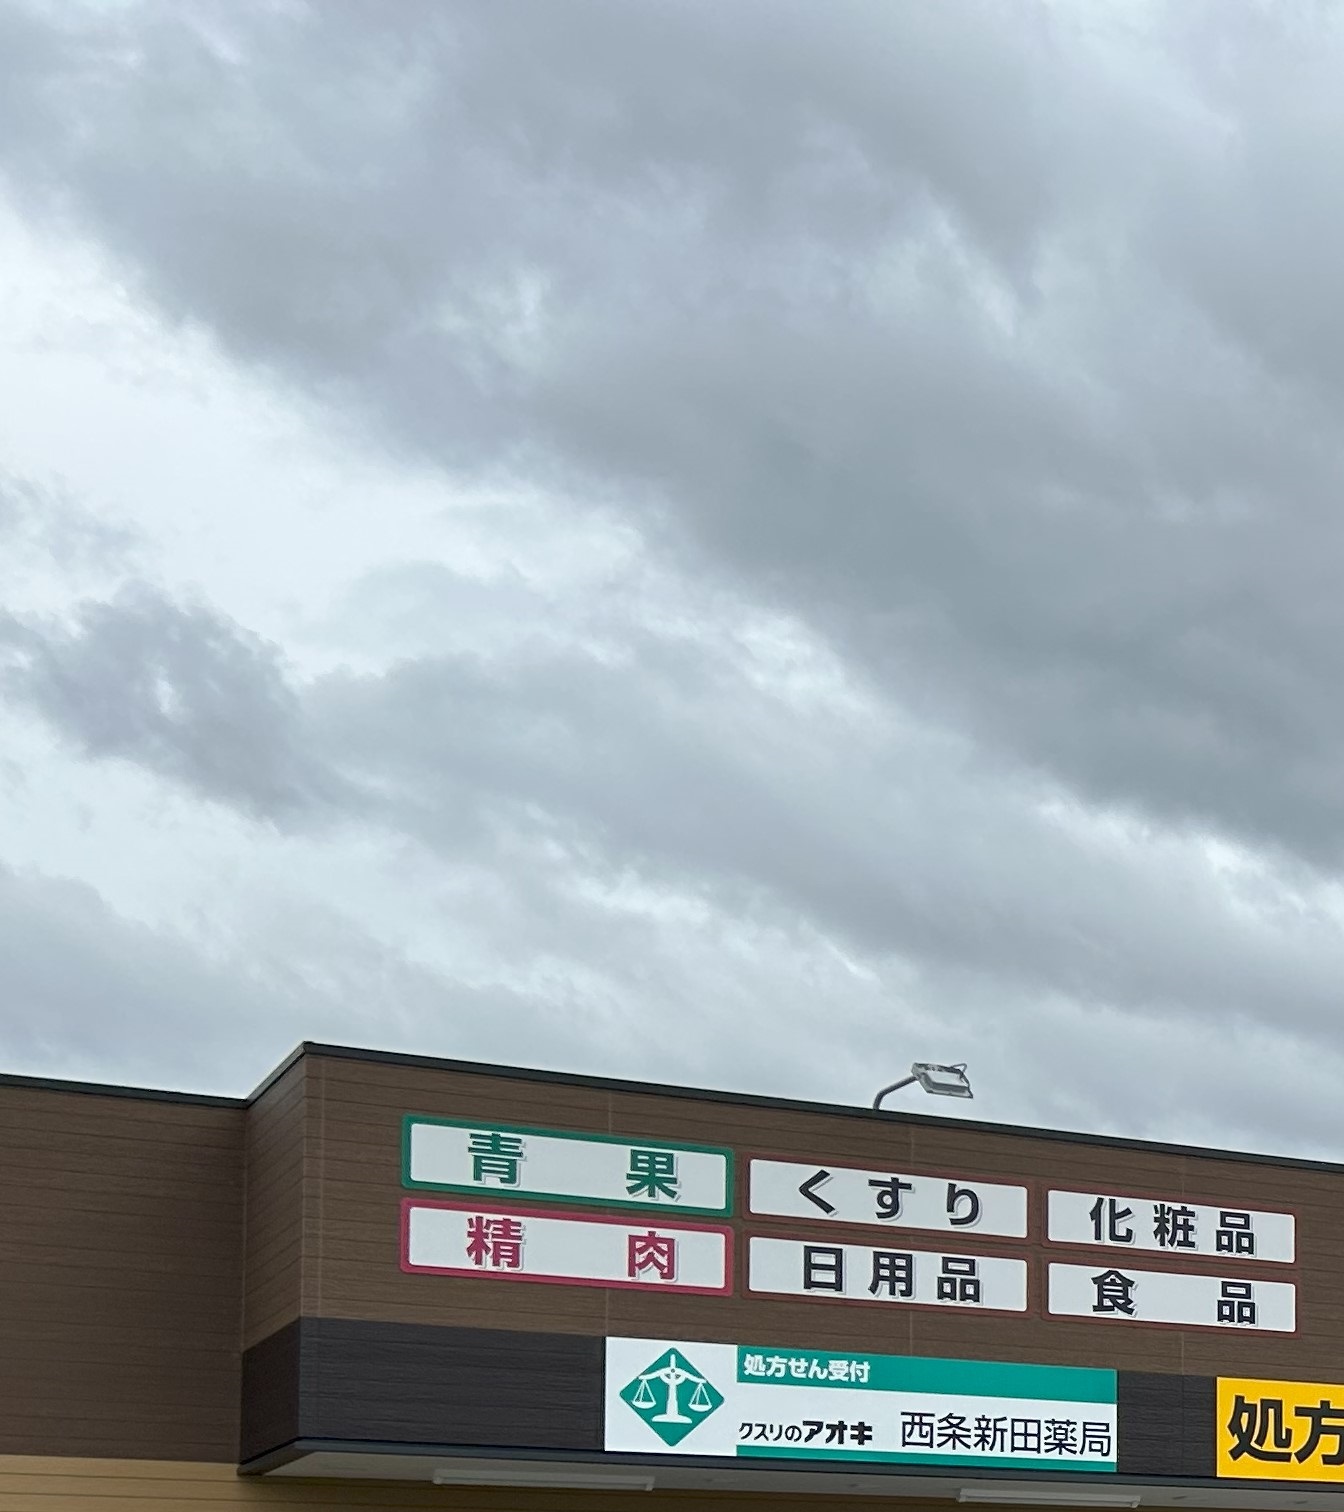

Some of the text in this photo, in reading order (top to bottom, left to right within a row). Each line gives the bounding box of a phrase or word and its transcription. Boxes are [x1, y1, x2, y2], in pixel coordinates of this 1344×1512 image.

[467, 1131, 681, 1199] 青果
[798, 1167, 983, 1230] くすり
[1088, 1195, 1257, 1255] 化粧品
[466, 1213, 679, 1285] 精肉
[803, 1244, 982, 1305] 日用品
[1090, 1269, 1259, 1327] 食品
[743, 1353, 871, 1385] 処方せん受付
[738, 1411, 1112, 1459] クスリのアオキ 西条新田薬局
